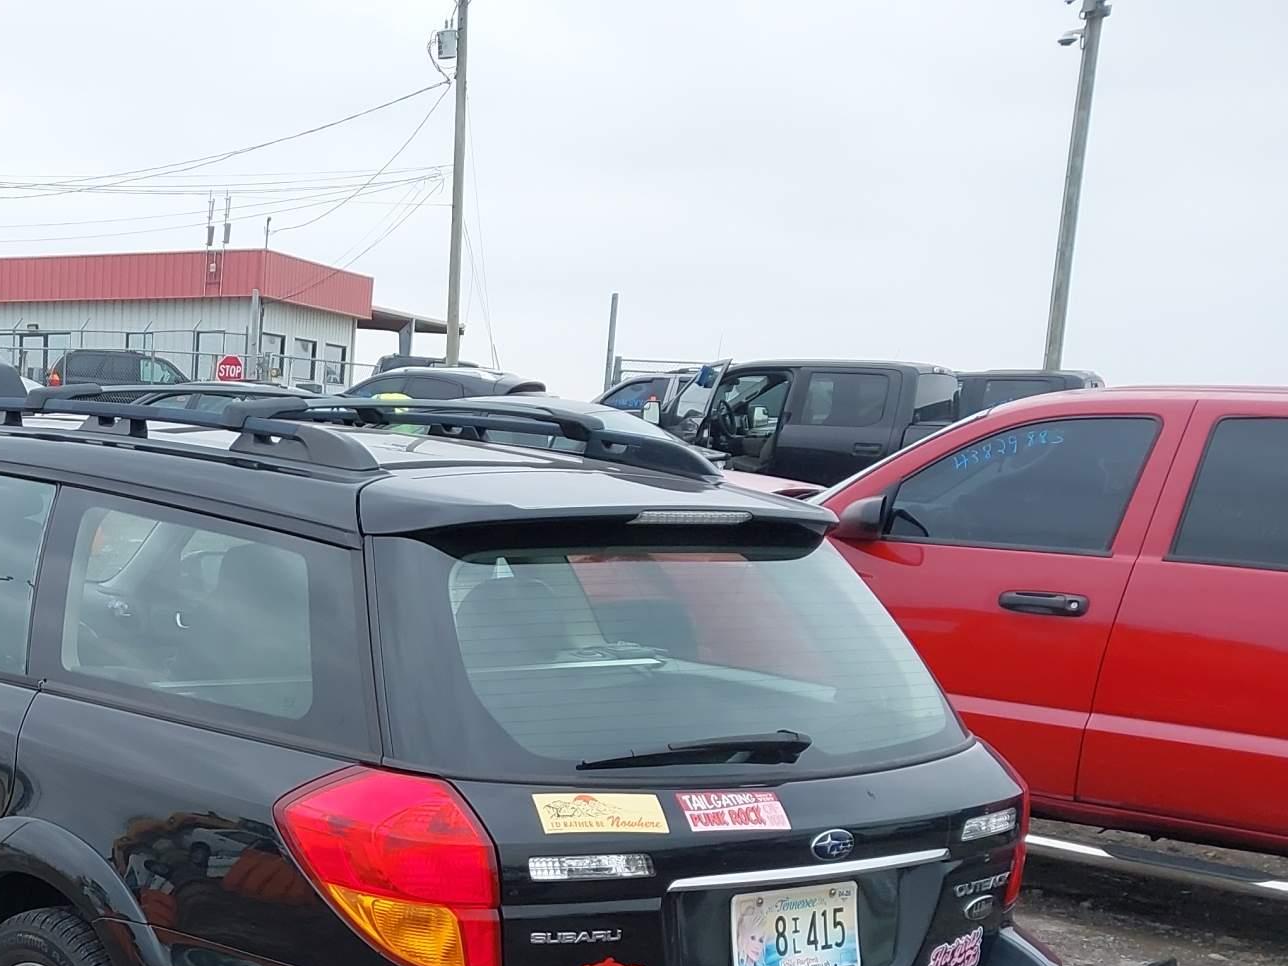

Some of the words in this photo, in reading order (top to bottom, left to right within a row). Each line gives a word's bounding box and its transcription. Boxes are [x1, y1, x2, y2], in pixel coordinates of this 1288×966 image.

[218, 364, 242, 377] STOP
[681, 792, 756, 810] TAILGATING
[563, 820, 593, 829] RATHER
[593, 820, 605, 829] BE
[606, 815, 664, 829] Nowhere
[688, 809, 730, 828] PUNK
[727, 803, 767, 827] ROCK
[775, 897, 818, 912] Tennessee
[530, 928, 623, 944] SUBARU
